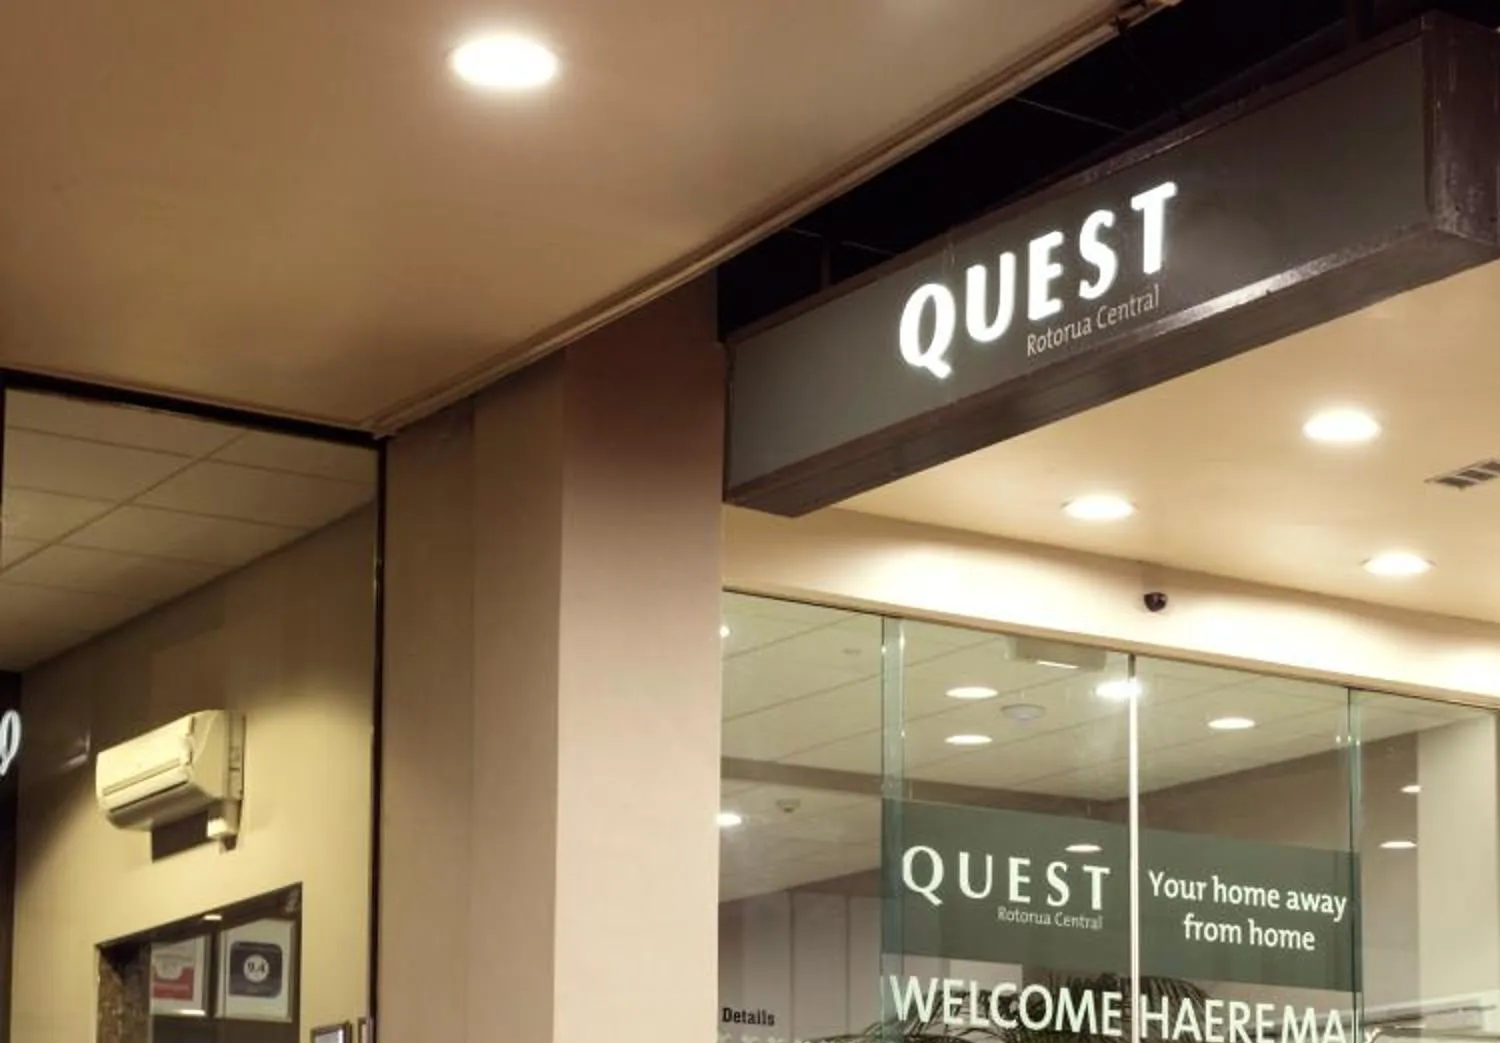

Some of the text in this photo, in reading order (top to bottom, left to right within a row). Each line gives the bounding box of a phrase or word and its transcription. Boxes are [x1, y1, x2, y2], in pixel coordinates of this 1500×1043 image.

[900, 181, 1177, 379] QUEST
[1027, 283, 1160, 357] Rotorua Central
[902, 845, 1111, 907] QUEST
[1148, 869, 1347, 922] Your home away
[998, 906, 1103, 930] Rotorua Central
[1184, 913, 1315, 951] from home
[722, 1007, 776, 1026] Details
[889, 975, 1123, 1037] WELCOME
